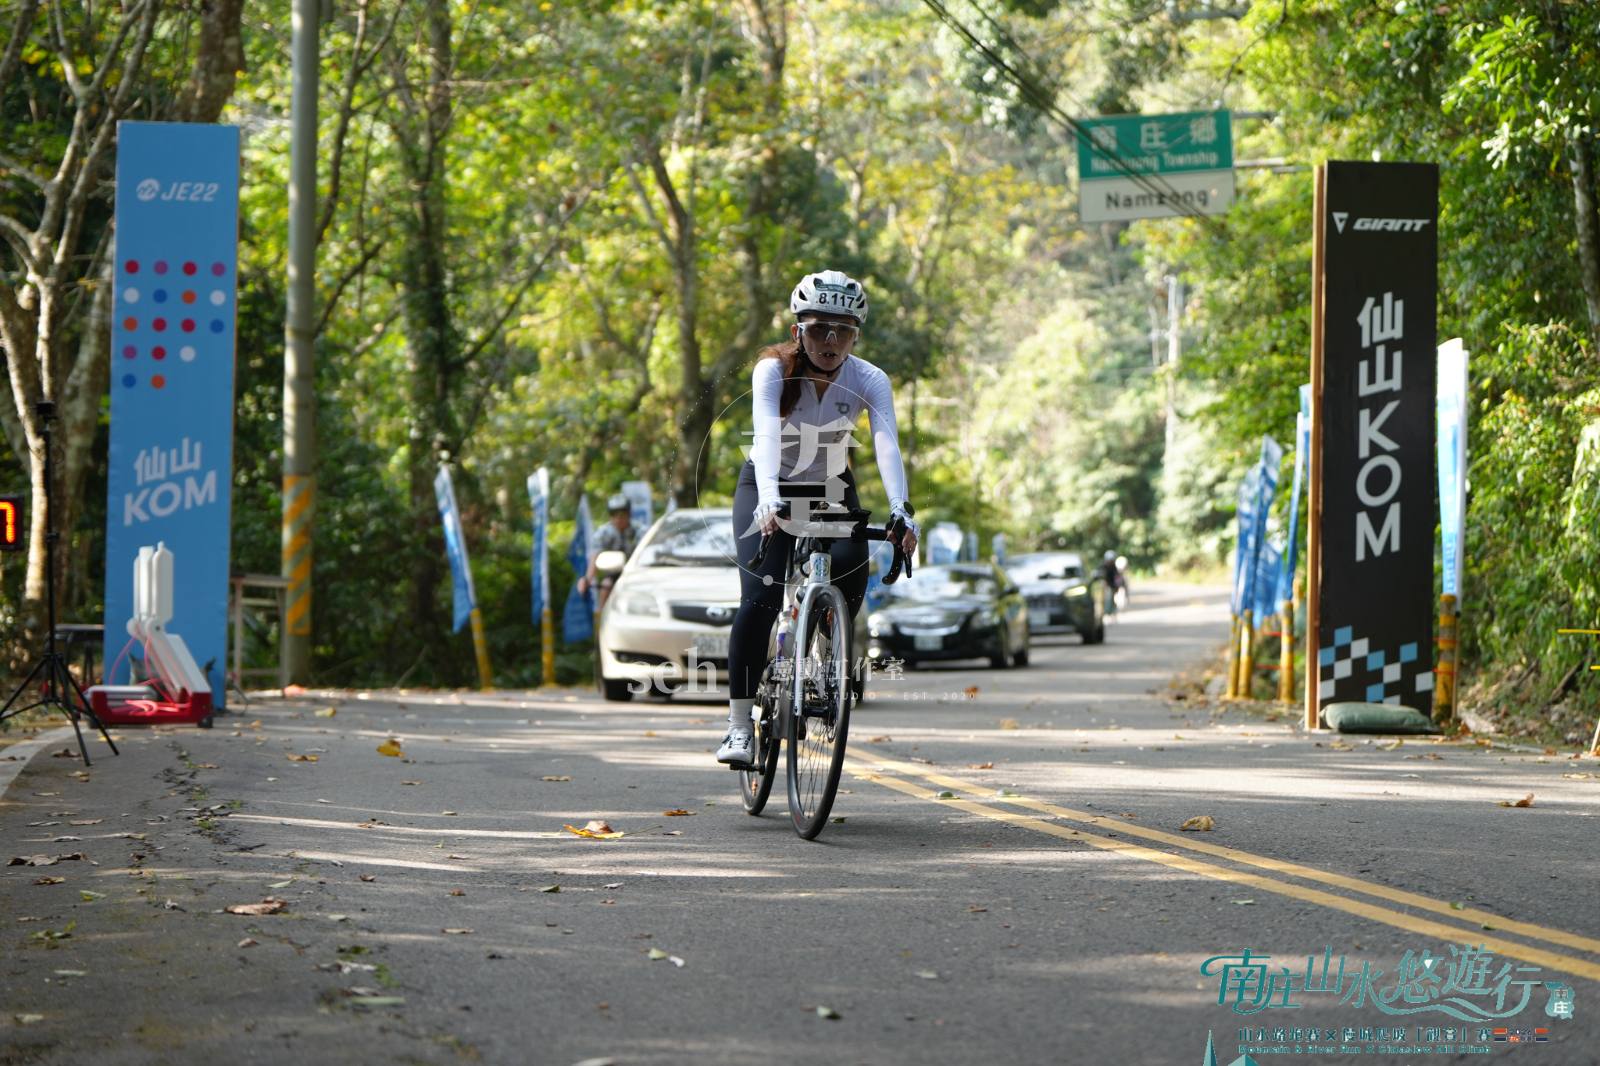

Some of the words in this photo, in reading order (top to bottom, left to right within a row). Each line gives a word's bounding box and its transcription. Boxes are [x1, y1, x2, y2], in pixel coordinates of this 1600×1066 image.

[1163, 151, 1218, 167] Township
[160, 182, 219, 201] JE22
[1353, 218, 1430, 232] GIANT
[133, 437, 202, 486] 仙山
[124, 470, 217, 526] KOM
